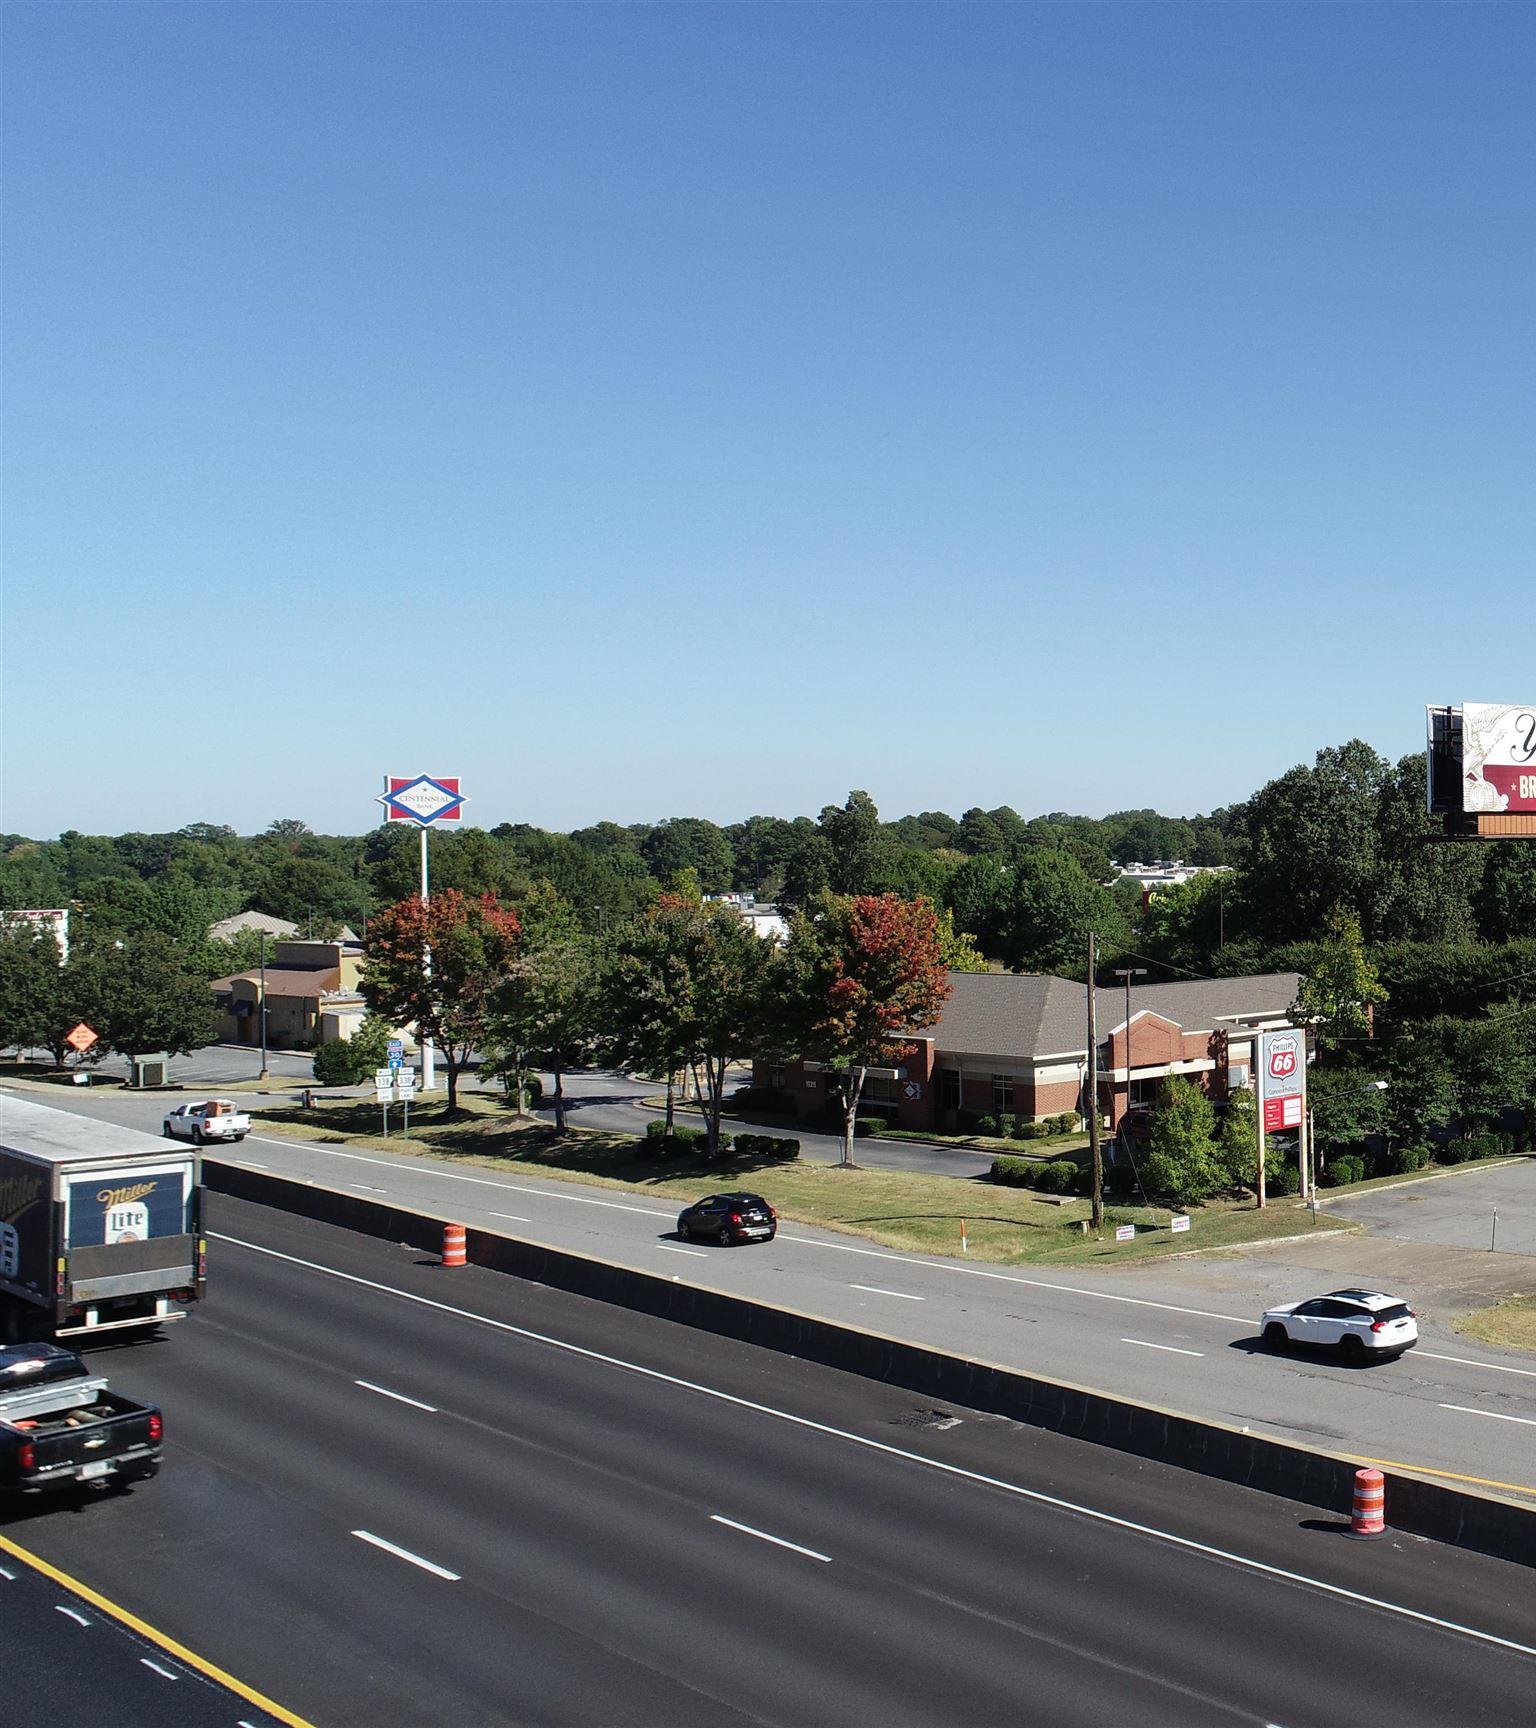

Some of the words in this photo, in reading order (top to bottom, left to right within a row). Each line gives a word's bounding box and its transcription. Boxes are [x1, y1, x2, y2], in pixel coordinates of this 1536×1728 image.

[1272, 1042, 1294, 1052] PHILLIPS
[1273, 1053, 1293, 1072] 66
[96, 1181, 159, 1214] Miller
[112, 1211, 143, 1232] Lite
